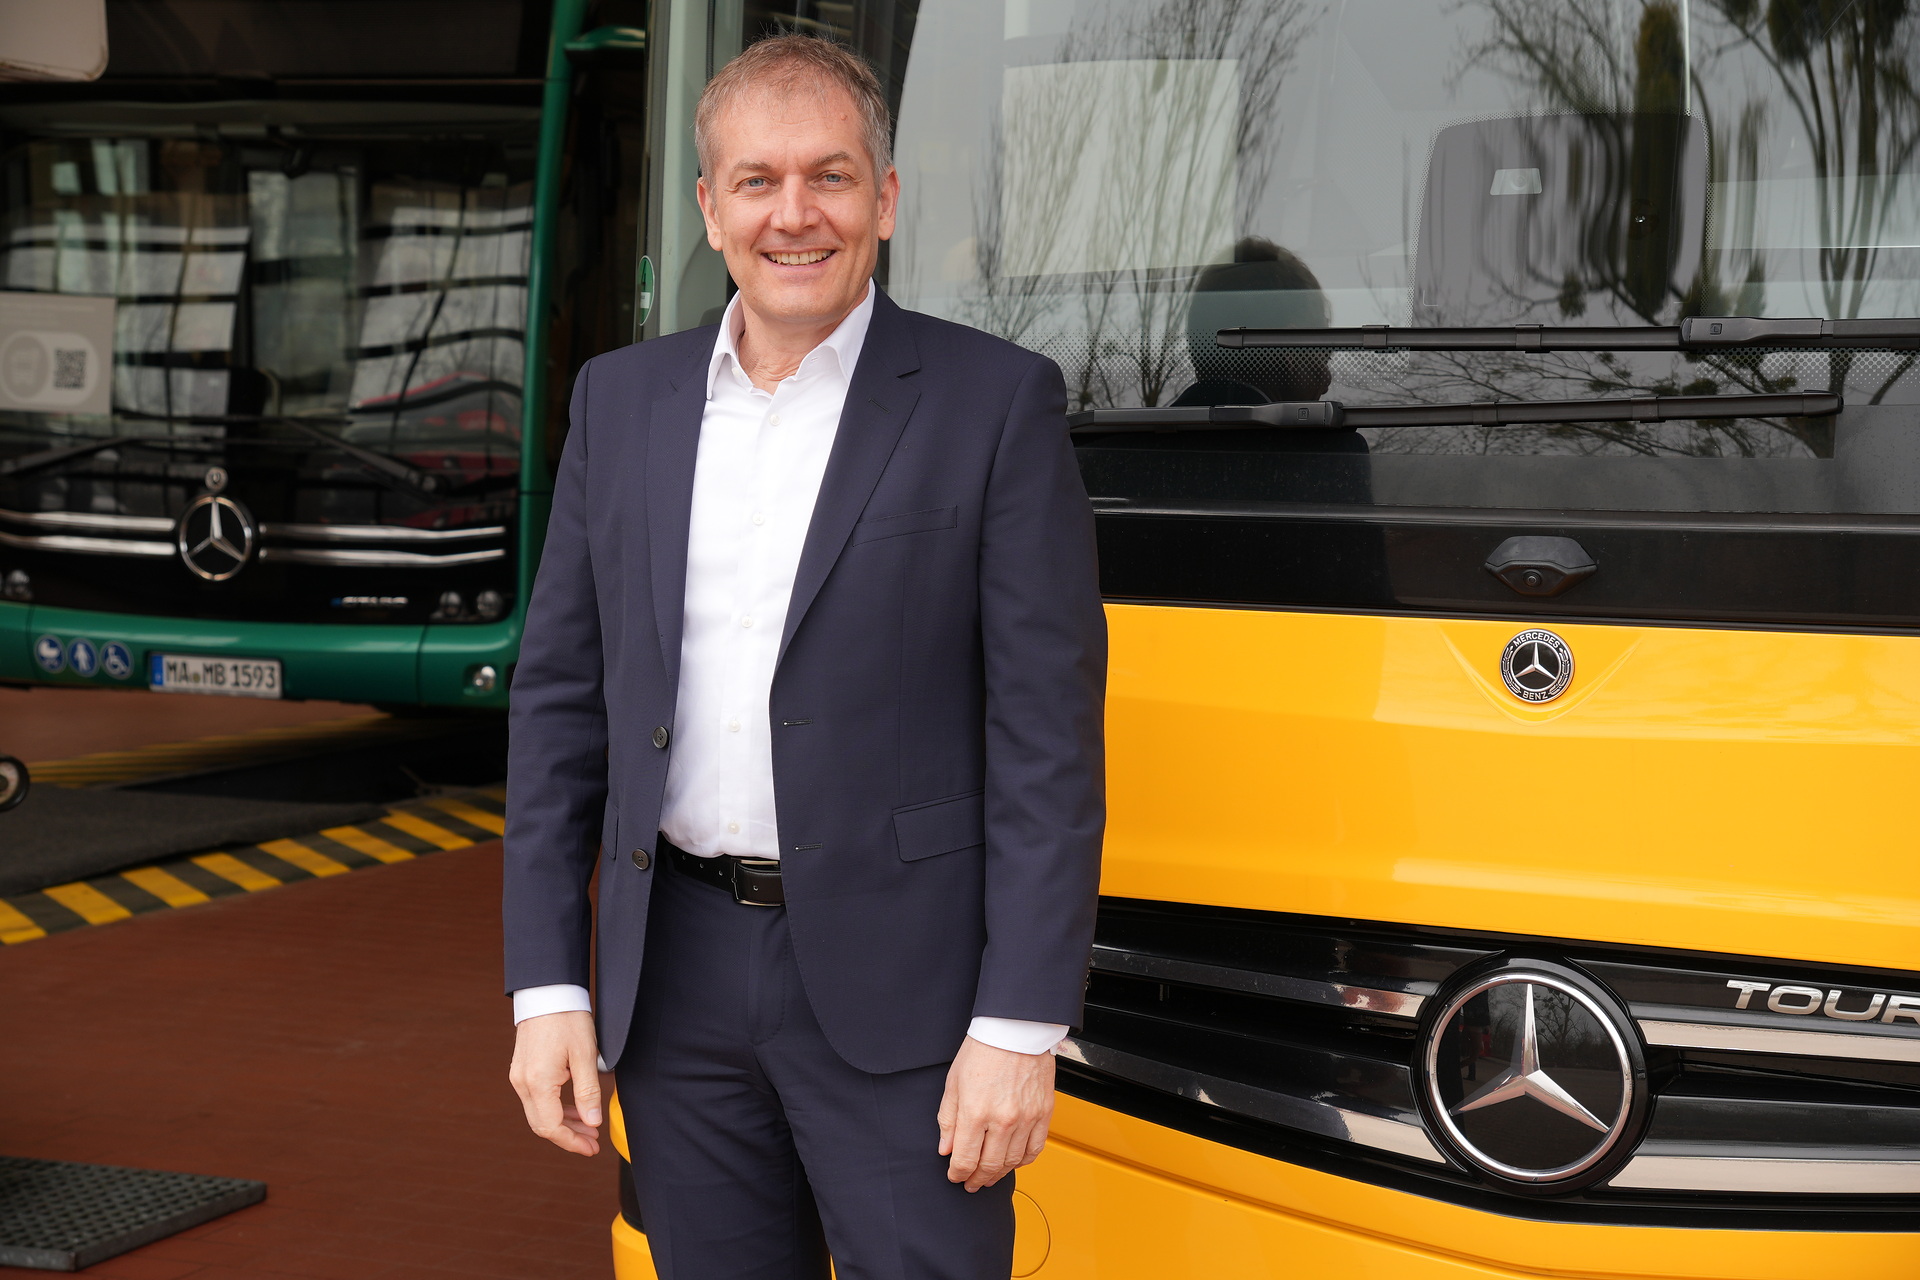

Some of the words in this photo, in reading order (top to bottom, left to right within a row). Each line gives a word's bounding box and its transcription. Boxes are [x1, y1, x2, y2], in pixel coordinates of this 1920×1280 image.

[1513, 632, 1560, 648] MERCEDES
[166, 661, 189, 682] MA
[202, 663, 226, 685] MB
[230, 664, 275, 688] 1593
[1522, 691, 1548, 700] BENZ
